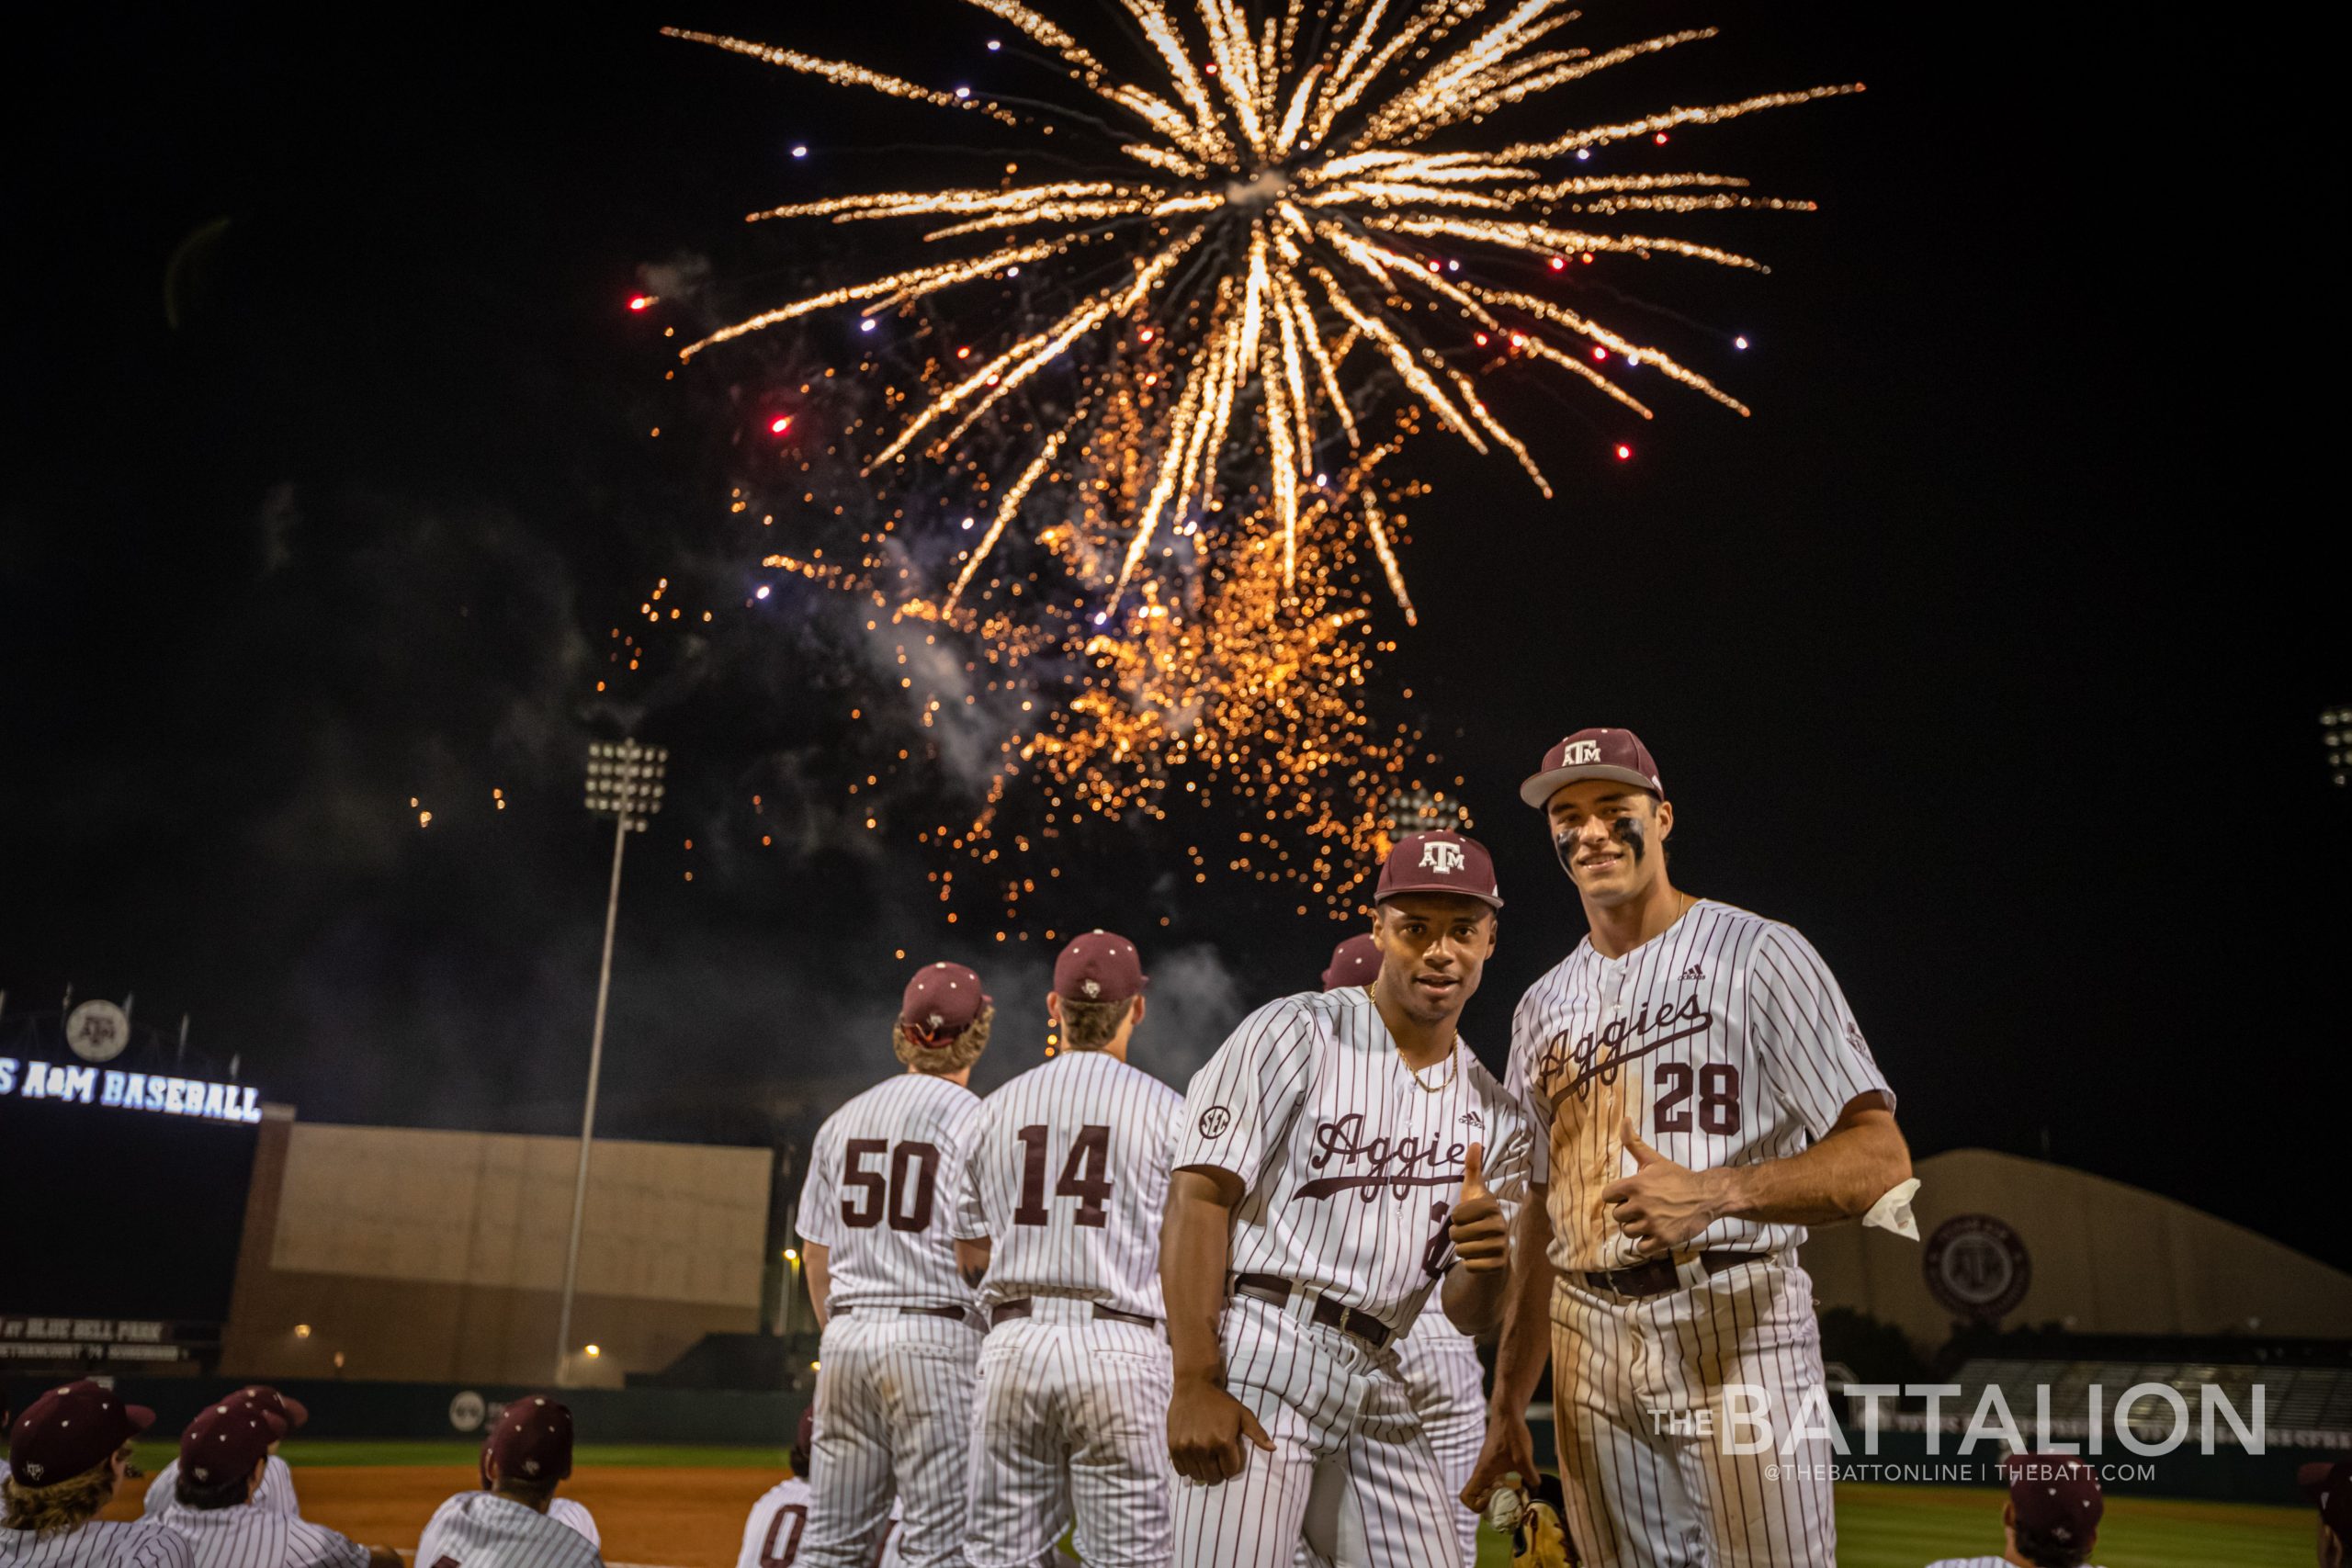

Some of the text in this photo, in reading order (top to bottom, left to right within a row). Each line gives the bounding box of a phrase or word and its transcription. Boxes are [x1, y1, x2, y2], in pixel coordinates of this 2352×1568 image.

[22, 1061, 98, 1102] A&M
[101, 1070, 263, 1123] BASEBALL
[1539, 994, 1702, 1102] Aggies
[1654, 1063, 1741, 1136] 28
[842, 1138, 941, 1233] 50
[1014, 1125, 1114, 1228] 14
[1311, 1113, 1485, 1203] Aggie
[26, 1317, 72, 1339] BLUE
[73, 1319, 114, 1341] BELL
